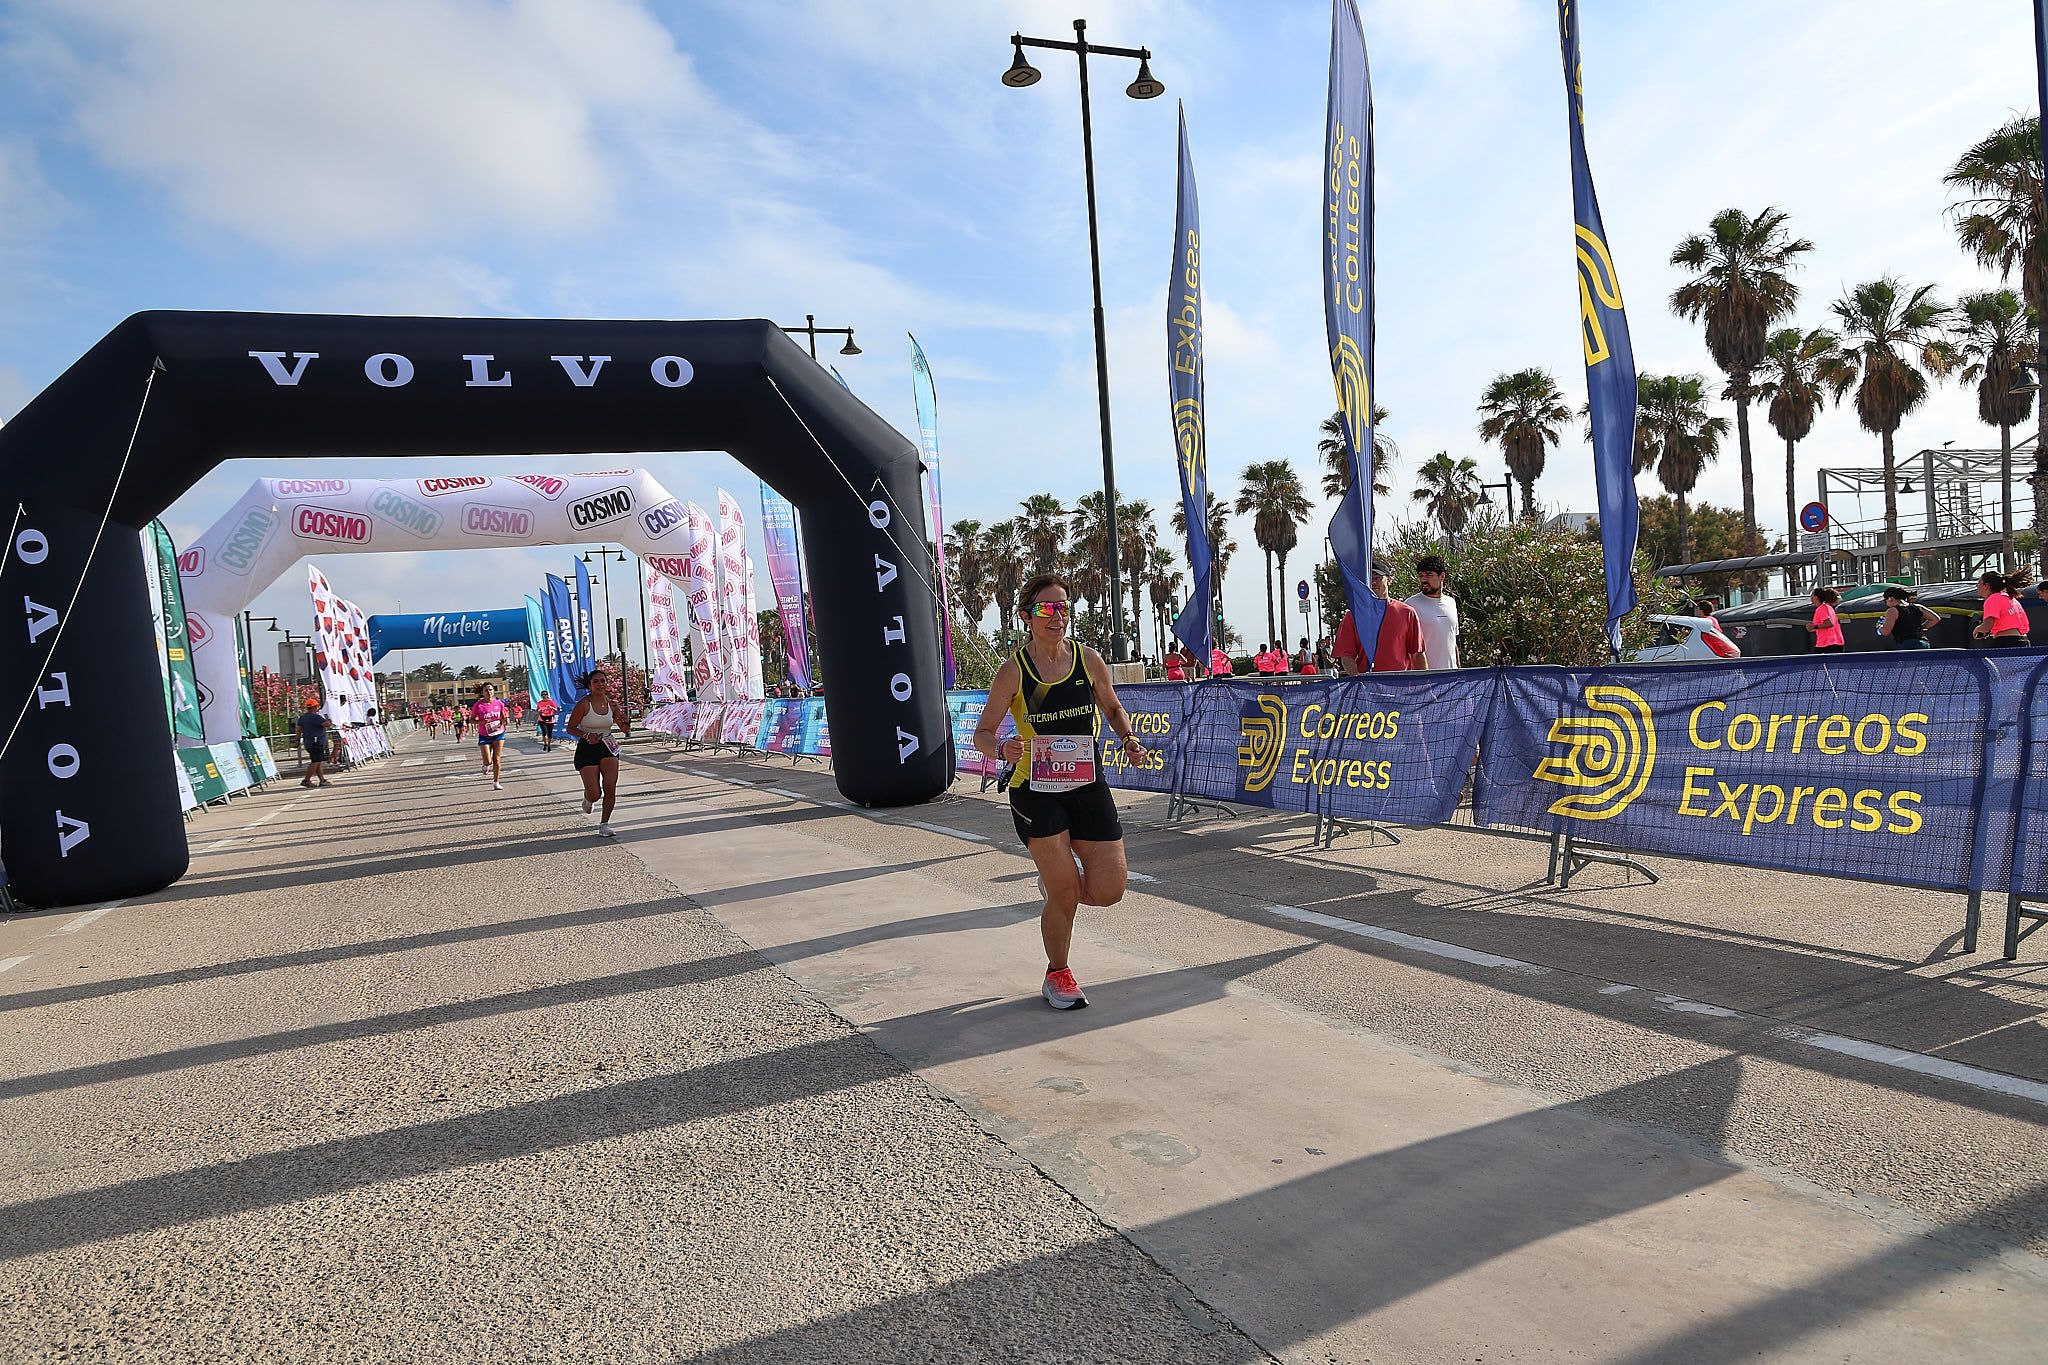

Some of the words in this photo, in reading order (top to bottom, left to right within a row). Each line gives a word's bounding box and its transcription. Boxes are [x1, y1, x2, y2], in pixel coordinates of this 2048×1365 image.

[248, 350, 694, 388] VOLVO
[299, 509, 366, 541] COSMO
[374, 491, 436, 535] COSMO
[467, 507, 529, 534] COSMO
[573, 487, 631, 525] COSMO
[645, 501, 688, 534] COSM
[221, 511, 271, 569] COSMO
[649, 556, 691, 577] COSM
[423, 614, 490, 643] Marlene
[868, 500, 921, 765] VOLVO
[15, 528, 90, 858] VOLVO
[1059, 703, 1093, 720] RUNNERS
[1300, 704, 1400, 740] Correos
[1688, 700, 1929, 757] Correos
[1052, 761, 1076, 772] 016
[1291, 748, 1392, 795] Express
[1678, 766, 1923, 836] Express
